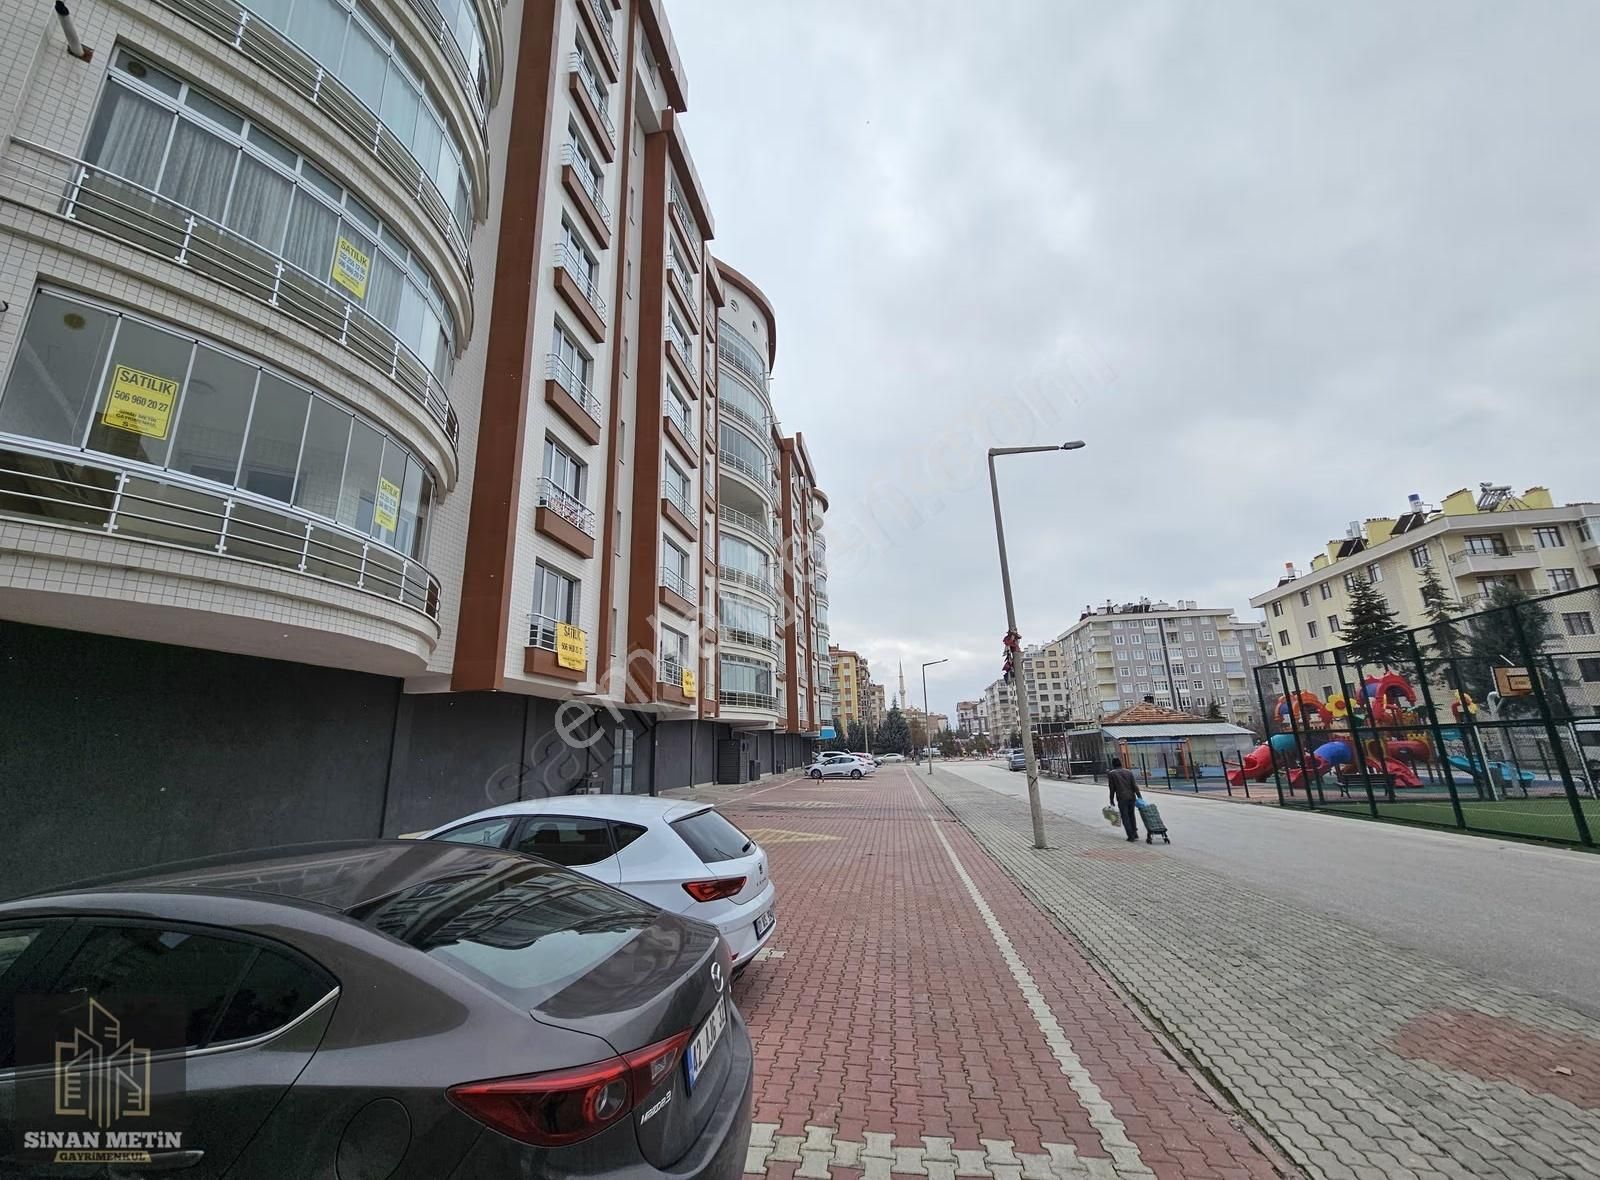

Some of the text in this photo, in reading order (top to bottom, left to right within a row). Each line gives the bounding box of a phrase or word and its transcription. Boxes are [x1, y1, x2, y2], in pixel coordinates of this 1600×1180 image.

[340, 240, 368, 267] SATILIK
[119, 370, 173, 395] SATILIK
[114, 390, 169, 413] 506 960 20 27
[693, 1039, 703, 1073] 42
